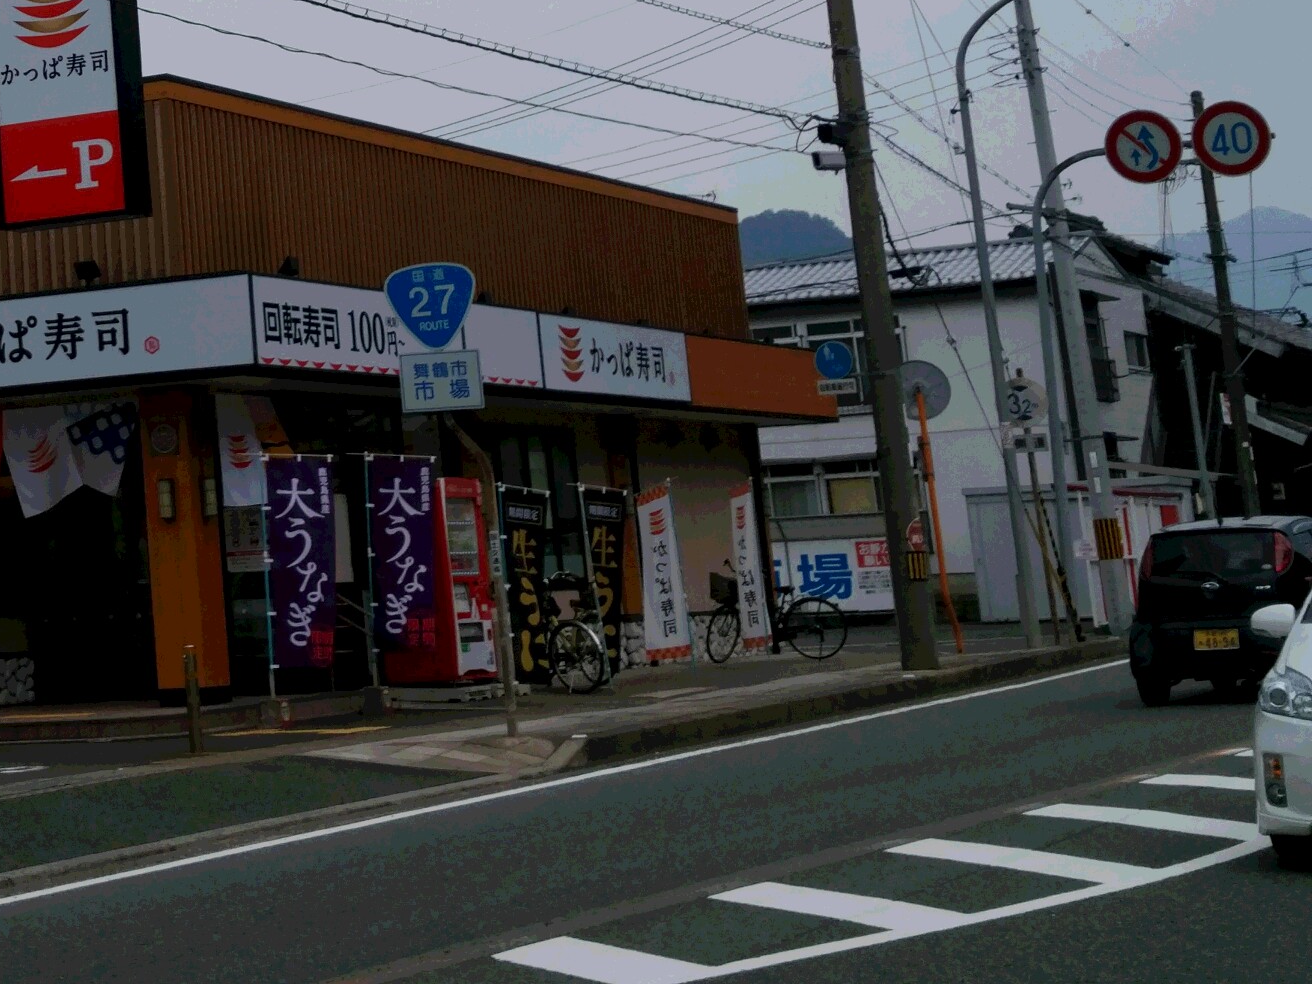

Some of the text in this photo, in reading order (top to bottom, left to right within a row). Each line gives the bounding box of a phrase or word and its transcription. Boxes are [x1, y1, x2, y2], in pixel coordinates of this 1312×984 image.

[1, 49, 109, 85] かっぱ寿司
[1212, 122, 1253, 155] 40
[72, 138, 113, 190] P
[409, 283, 455, 317] 27
[262, 302, 340, 350] 回転寿司
[419, 320, 450, 332] ROUTE
[413, 360, 467, 379] 舞鶴市
[589, 338, 668, 384] かっぱ寿司
[414, 378, 470, 401] 市場
[275, 478, 328, 646] 大うなぎ
[377, 477, 426, 634] 大うなぎ
